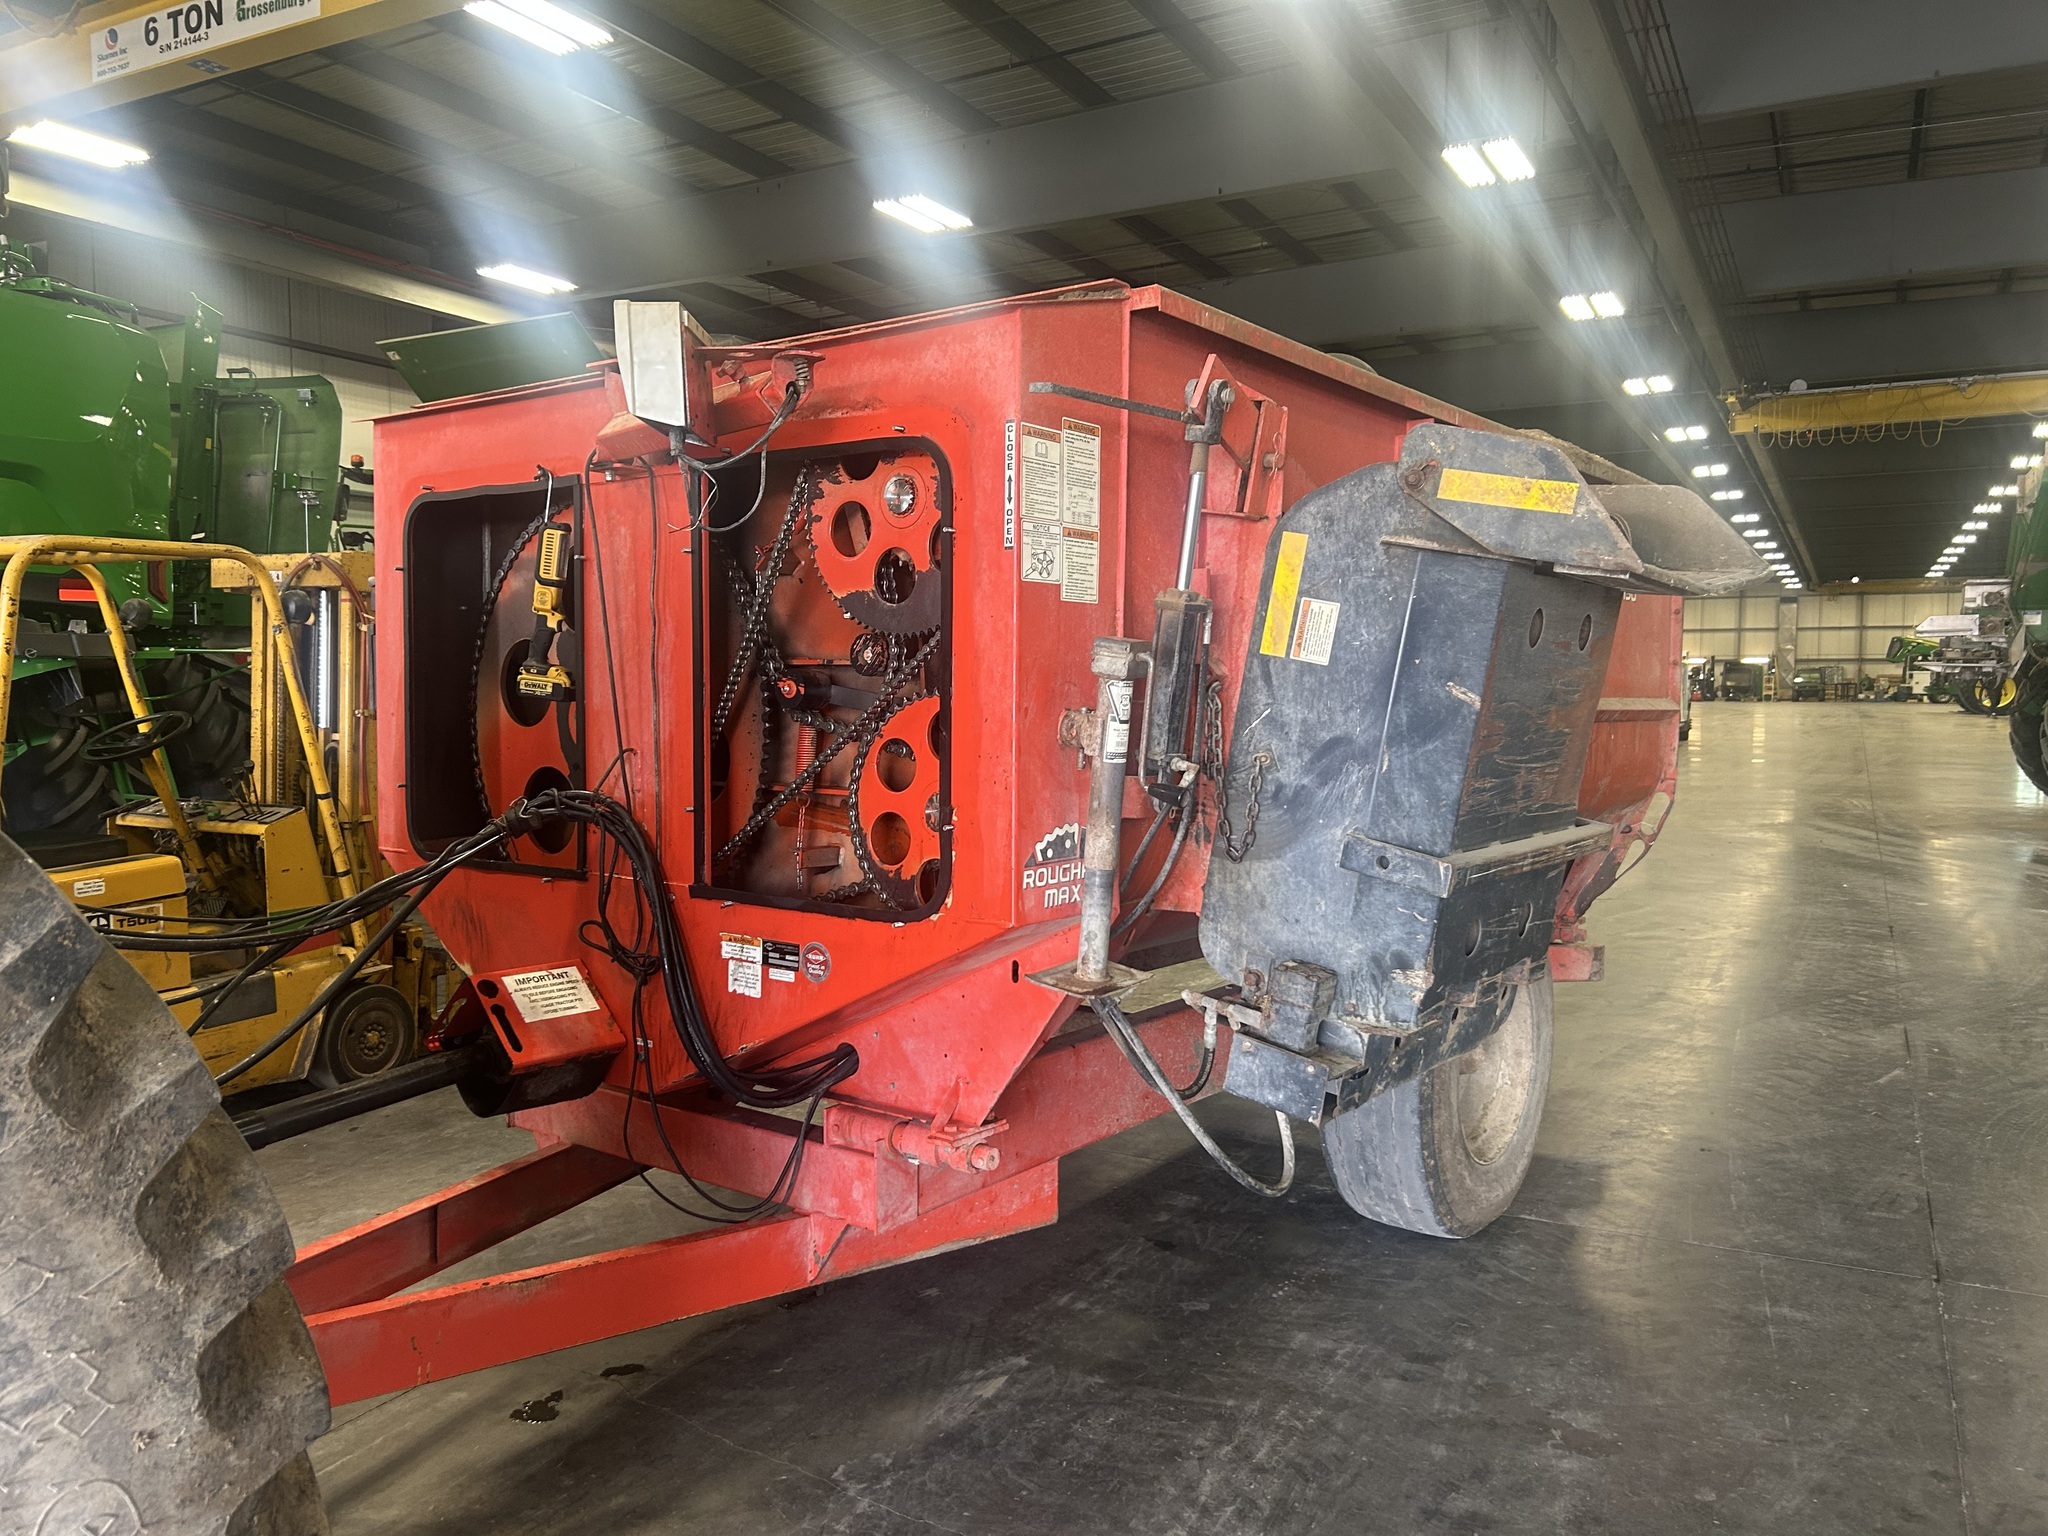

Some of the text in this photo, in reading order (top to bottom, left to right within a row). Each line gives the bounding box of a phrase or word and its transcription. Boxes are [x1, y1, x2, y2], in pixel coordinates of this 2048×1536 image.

[144, 0, 223, 46] 6 TON
[173, 32, 209, 49] 214144-3
[1033, 430, 1057, 441] WARNING
[1073, 423, 1096, 435] WARNING
[1005, 509, 1013, 544] OPEN
[1033, 524, 1051, 532] NOTICE
[1072, 531, 1094, 540] WARNING
[1297, 609, 1308, 642] WARNING
[1044, 884, 1081, 908] MAX
[515, 971, 569, 986] IMPORTANT
